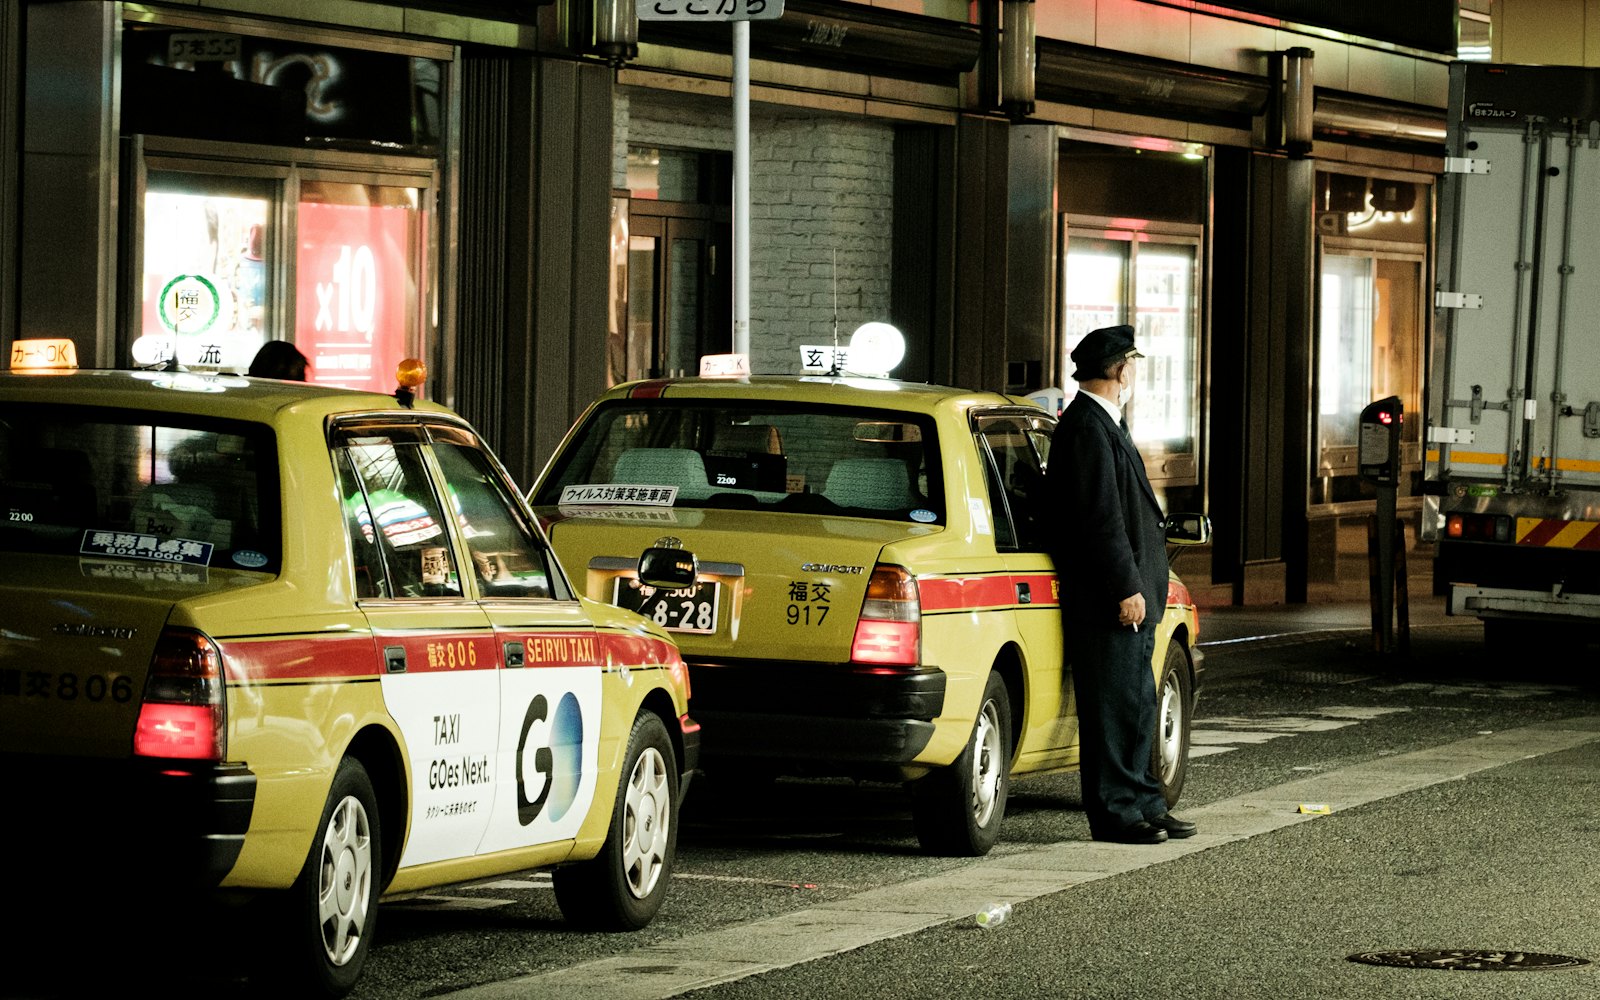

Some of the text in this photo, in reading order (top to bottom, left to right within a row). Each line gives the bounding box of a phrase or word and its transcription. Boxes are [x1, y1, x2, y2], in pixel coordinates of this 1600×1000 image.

[565, 487, 673, 503] ウイルス対策実施車両
[801, 563, 867, 575] COMFORT
[788, 580, 831, 603] 福交
[787, 604, 830, 626] 917
[527, 637, 595, 663] SEIRYU TAXI
[433, 713, 461, 746] TAXI
[429, 754, 490, 791] GOes Next.
